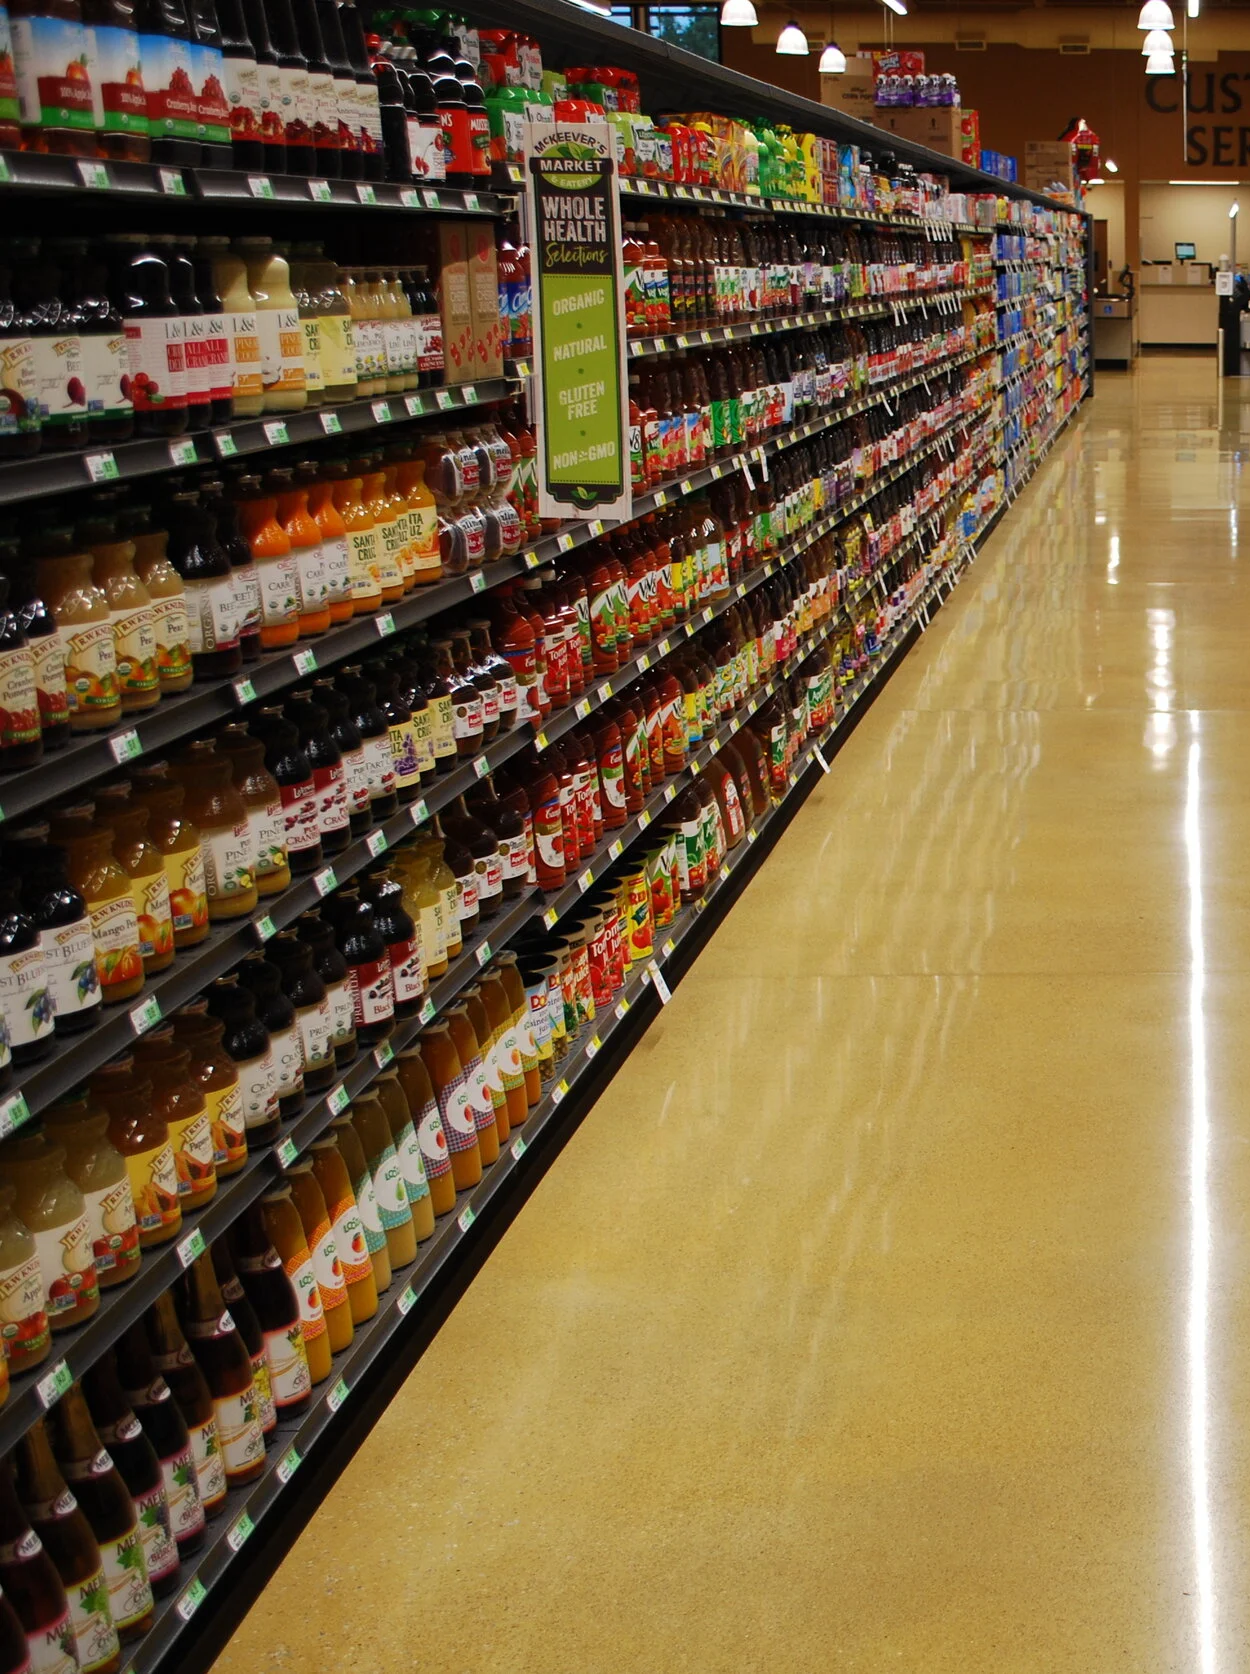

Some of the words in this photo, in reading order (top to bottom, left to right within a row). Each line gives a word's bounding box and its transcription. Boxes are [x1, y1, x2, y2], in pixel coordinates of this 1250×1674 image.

[540, 159, 602, 172] MARKET
[560, 176, 594, 187] EATERY
[542, 196, 606, 220] WHOLE
[544, 220, 606, 242] HEALTH
[545, 242, 608, 268] Selections
[552, 289, 605, 316] ORGANIC
[553, 335, 607, 361] NATURAL
[559, 380, 605, 405] GLUTEN
[567, 399, 598, 421] FREE
